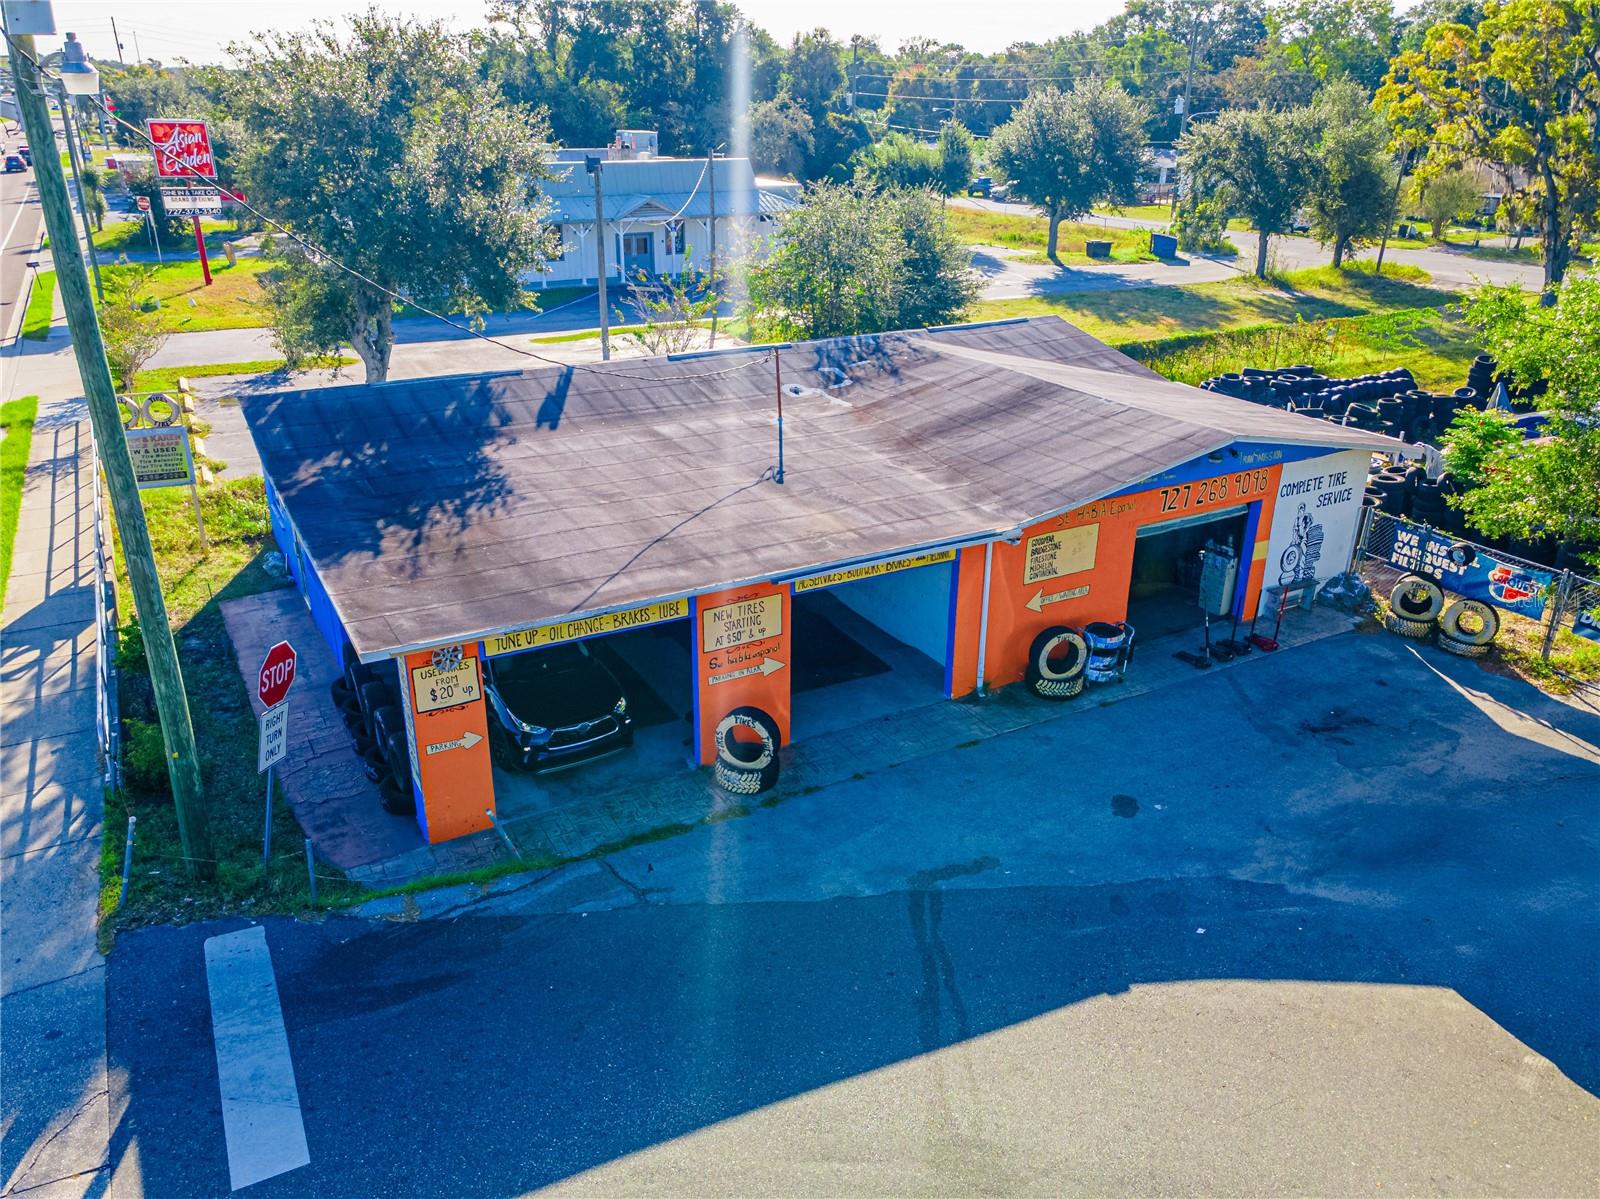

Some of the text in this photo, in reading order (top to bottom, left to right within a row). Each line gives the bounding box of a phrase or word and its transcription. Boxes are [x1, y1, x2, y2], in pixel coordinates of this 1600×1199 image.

[156, 126, 202, 152] Asian
[163, 146, 210, 172] Garden
[1160, 486, 1191, 513] 727
[1196, 477, 1228, 505] 268
[1235, 469, 1269, 496] 9098
[1280, 472, 1347, 498] COMPLETE TIRE
[1316, 488, 1352, 508] SERVICE
[1397, 530, 1419, 546] WE
[1031, 541, 1062, 557] BRIDGESTONE
[1030, 552, 1057, 565] FIRESTONE
[1030, 561, 1053, 573] MICHELIN
[713, 601, 765, 622] NEW TIRES
[1464, 602, 1485, 614] TIRES
[496, 601, 681, 652] TUNE UP OIL CHANGE BRAKES LUBE
[724, 615, 761, 632] STARTING
[715, 636, 723, 647] AT
[261, 658, 293, 693] STOP
[420, 668, 444, 680] USED
[435, 675, 459, 686] FROM
[462, 686, 473, 696] up
[265, 711, 284, 730] RIGHT
[735, 716, 756, 728] TIRES
[266, 727, 282, 746] TURN
[265, 743, 281, 761] ONLY
[430, 740, 461, 752] PARKING
